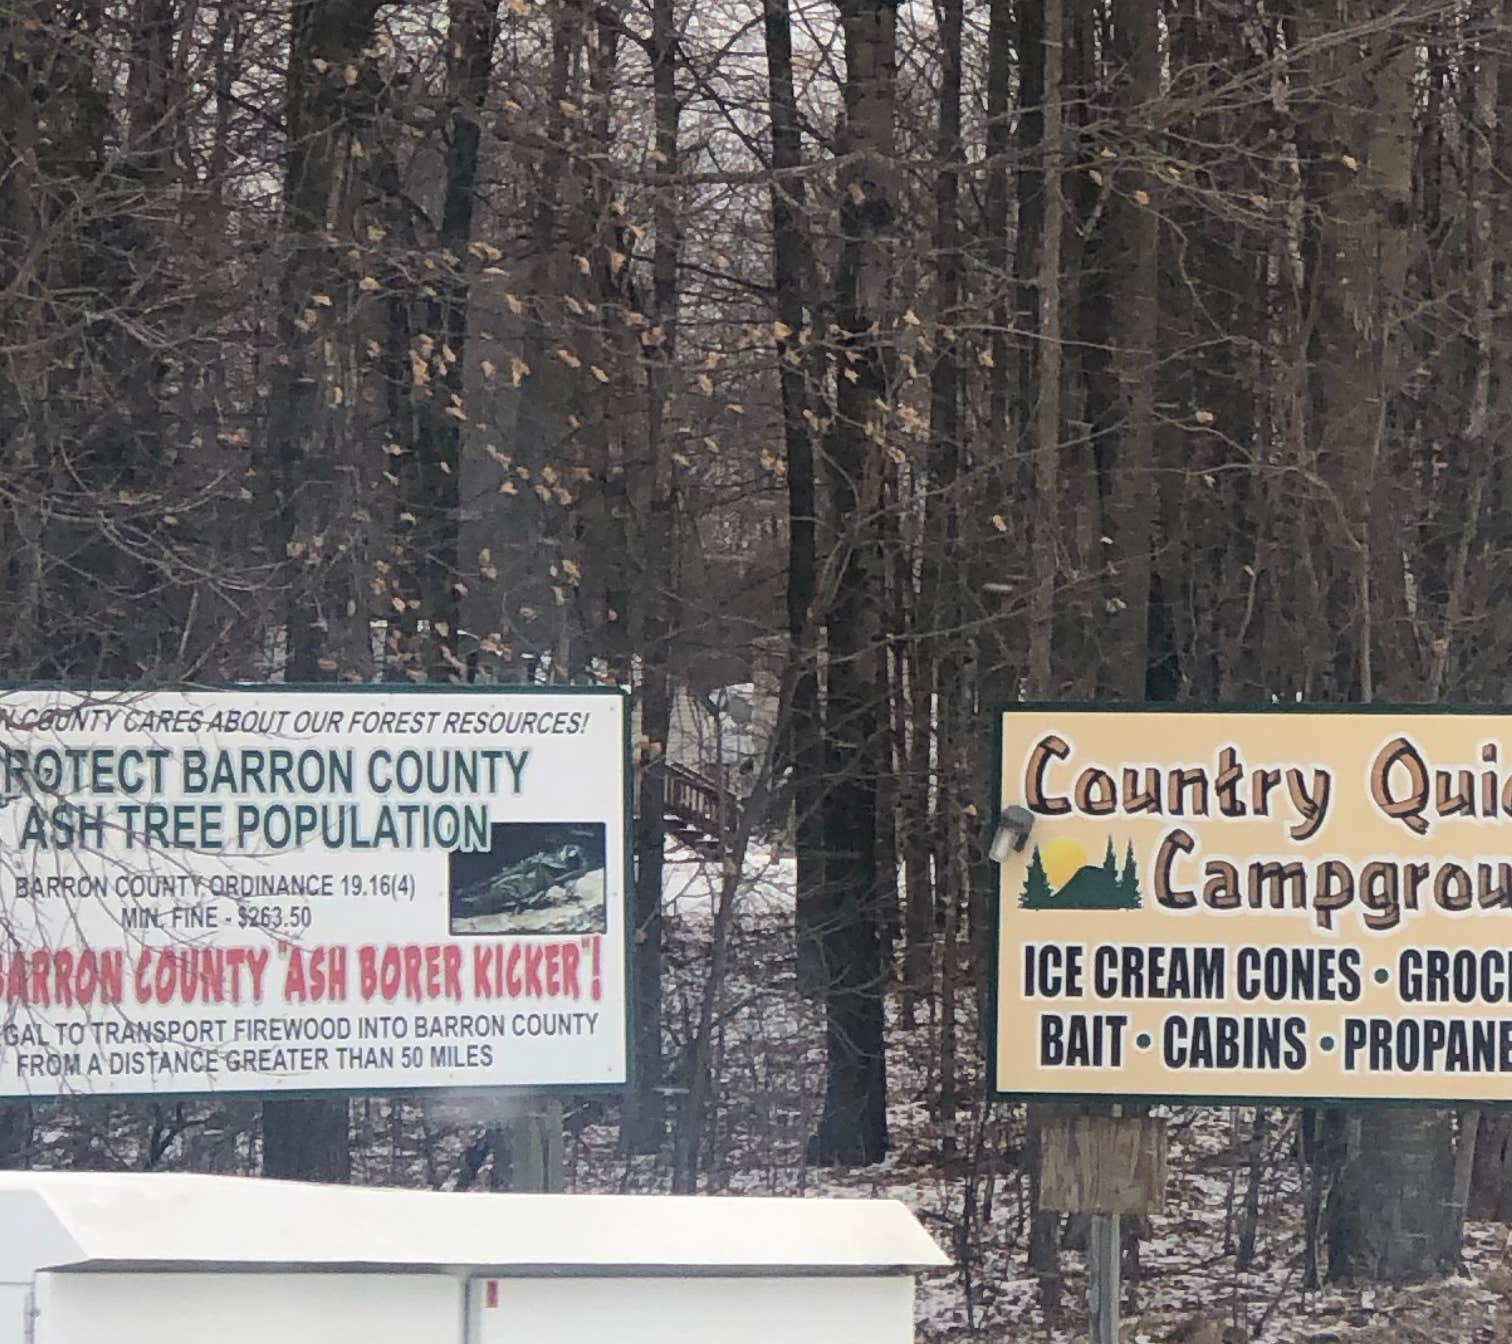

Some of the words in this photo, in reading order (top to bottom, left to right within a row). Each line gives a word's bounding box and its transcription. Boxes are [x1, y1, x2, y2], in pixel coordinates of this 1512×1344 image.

[22, 709, 120, 732] COUNTY
[124, 710, 203, 733] CARES
[206, 710, 289, 734] ABOUT
[294, 711, 343, 734] OUR
[348, 711, 440, 734] FOREST
[443, 712, 591, 735] RESOURCES!
[183, 749, 351, 794] BARRON
[368, 749, 529, 794] COUNTY
[1025, 735, 1331, 840] Country
[19, 805, 103, 850] ASH
[118, 805, 223, 849] TREE
[238, 805, 488, 849] POPULATION
[15, 876, 108, 899] BARRON
[115, 875, 202, 899] COUNTY
[209, 875, 333, 898] ORDINANCE
[340, 874, 416, 902] 19.16(4)
[172, 906, 218, 929] FINE
[238, 905, 312, 930] $263.50
[135, 946, 269, 1005] COUNTY
[278, 940, 347, 1002] "ASH
[358, 944, 462, 1003] BORER
[474, 935, 602, 1002] KICKER"!
[1024, 945, 1083, 998] ICE
[1094, 945, 1225, 1000] CREAM
[1236, 947, 1361, 1002] CONES
[0, 1022, 49, 1047] GAL
[56, 1022, 84, 1046] TO
[92, 1020, 226, 1045] TRANSPORT
[234, 1016, 350, 1042] FIREWOOD
[359, 1016, 408, 1040] INTO
[414, 1014, 505, 1039] BARRON
[512, 1012, 599, 1036] COUNTY
[1040, 1014, 1127, 1067] BAIT
[1163, 1015, 1307, 1071] CABINS
[17, 1053, 81, 1077] FROM
[88, 1053, 103, 1075] A
[110, 1050, 218, 1075] DISTANCE
[226, 1047, 328, 1072] GREATER
[336, 1045, 393, 1070] THAN
[402, 1045, 424, 1068] 50
[430, 1043, 493, 1068] MILES
